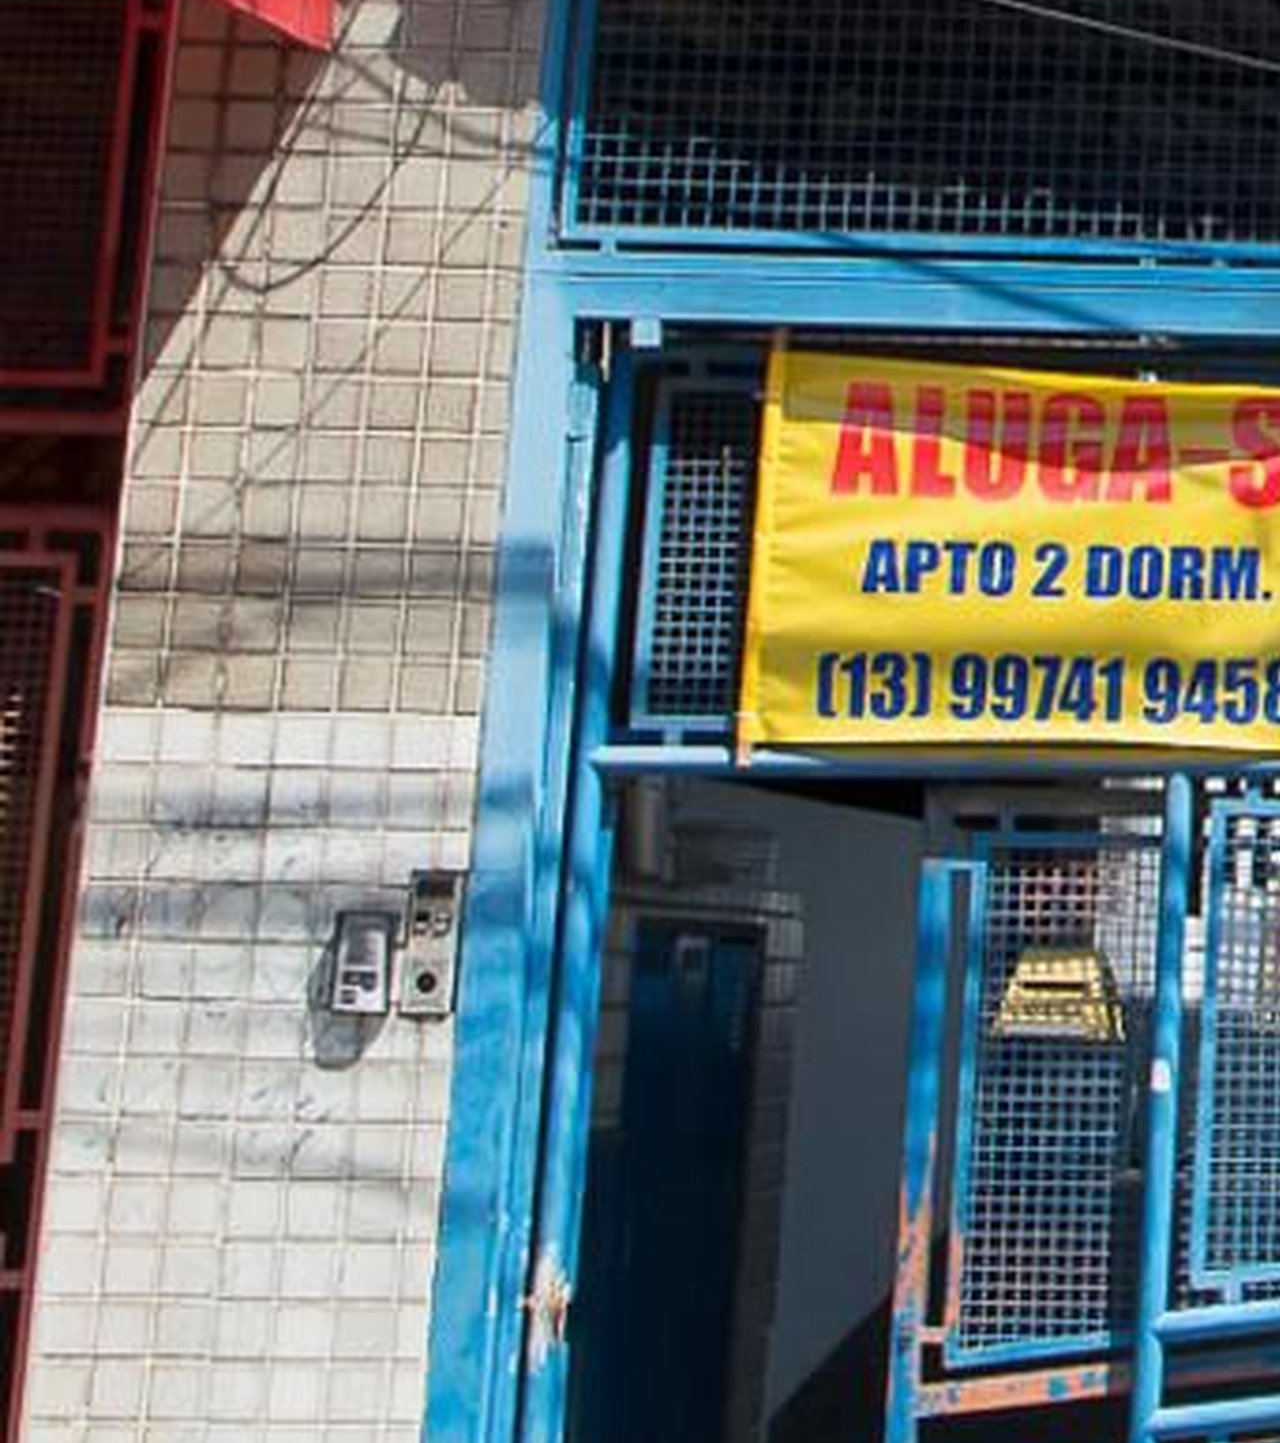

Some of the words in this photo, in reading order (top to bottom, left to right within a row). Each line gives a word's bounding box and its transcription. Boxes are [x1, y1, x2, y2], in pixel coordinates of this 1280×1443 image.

[862, 539, 1017, 596] APTO
[1032, 544, 1066, 599] 2
[1086, 546, 1274, 602] DORM.
[815, 650, 932, 720] (13)
[948, 653, 1124, 721] 99741
